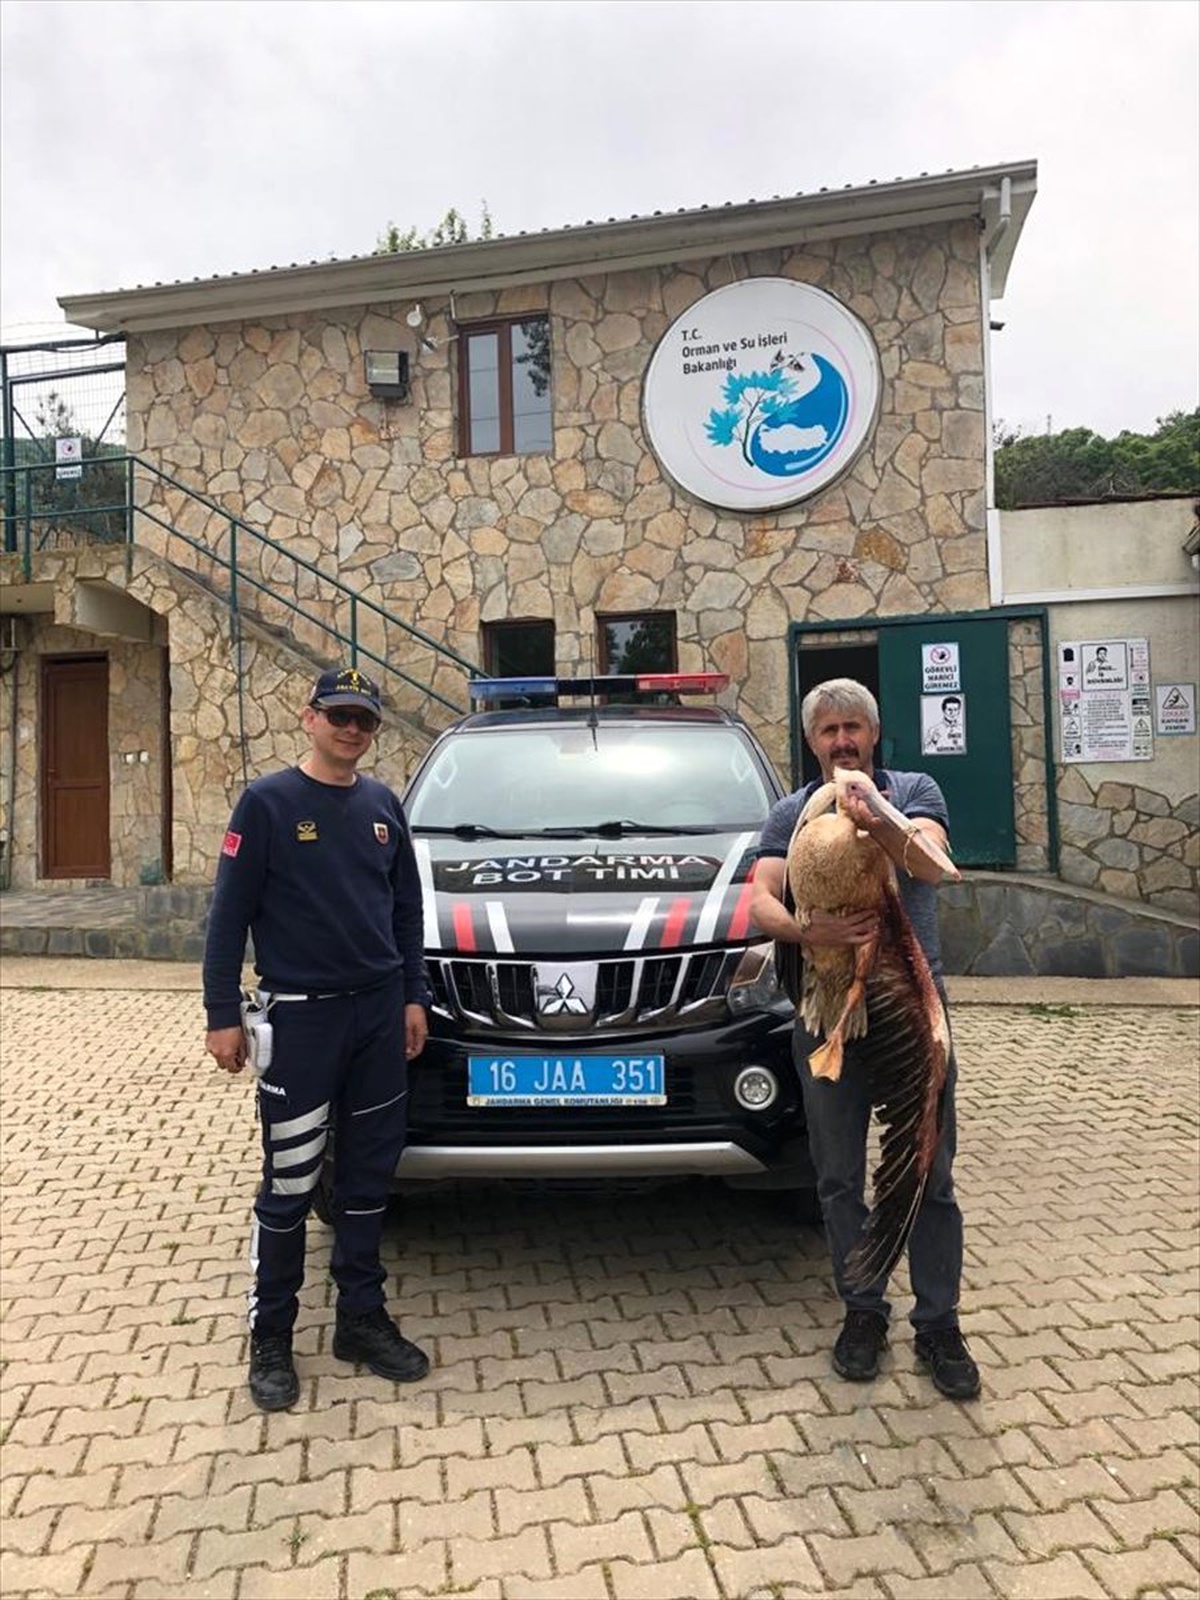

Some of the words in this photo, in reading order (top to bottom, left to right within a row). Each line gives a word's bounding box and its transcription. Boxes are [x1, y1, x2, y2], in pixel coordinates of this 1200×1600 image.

[681, 328, 702, 341] T.C.
[682, 343, 720, 358] Orman
[722, 341, 738, 352] ve
[740, 337, 756, 350] Su
[683, 357, 737, 375] Bakanlığı
[445, 854, 710, 872] JANDARMA
[472, 868, 572, 885] BOT
[490, 1060, 517, 1092] 16
[534, 1060, 587, 1091] JAA
[611, 1060, 656, 1091] 351
